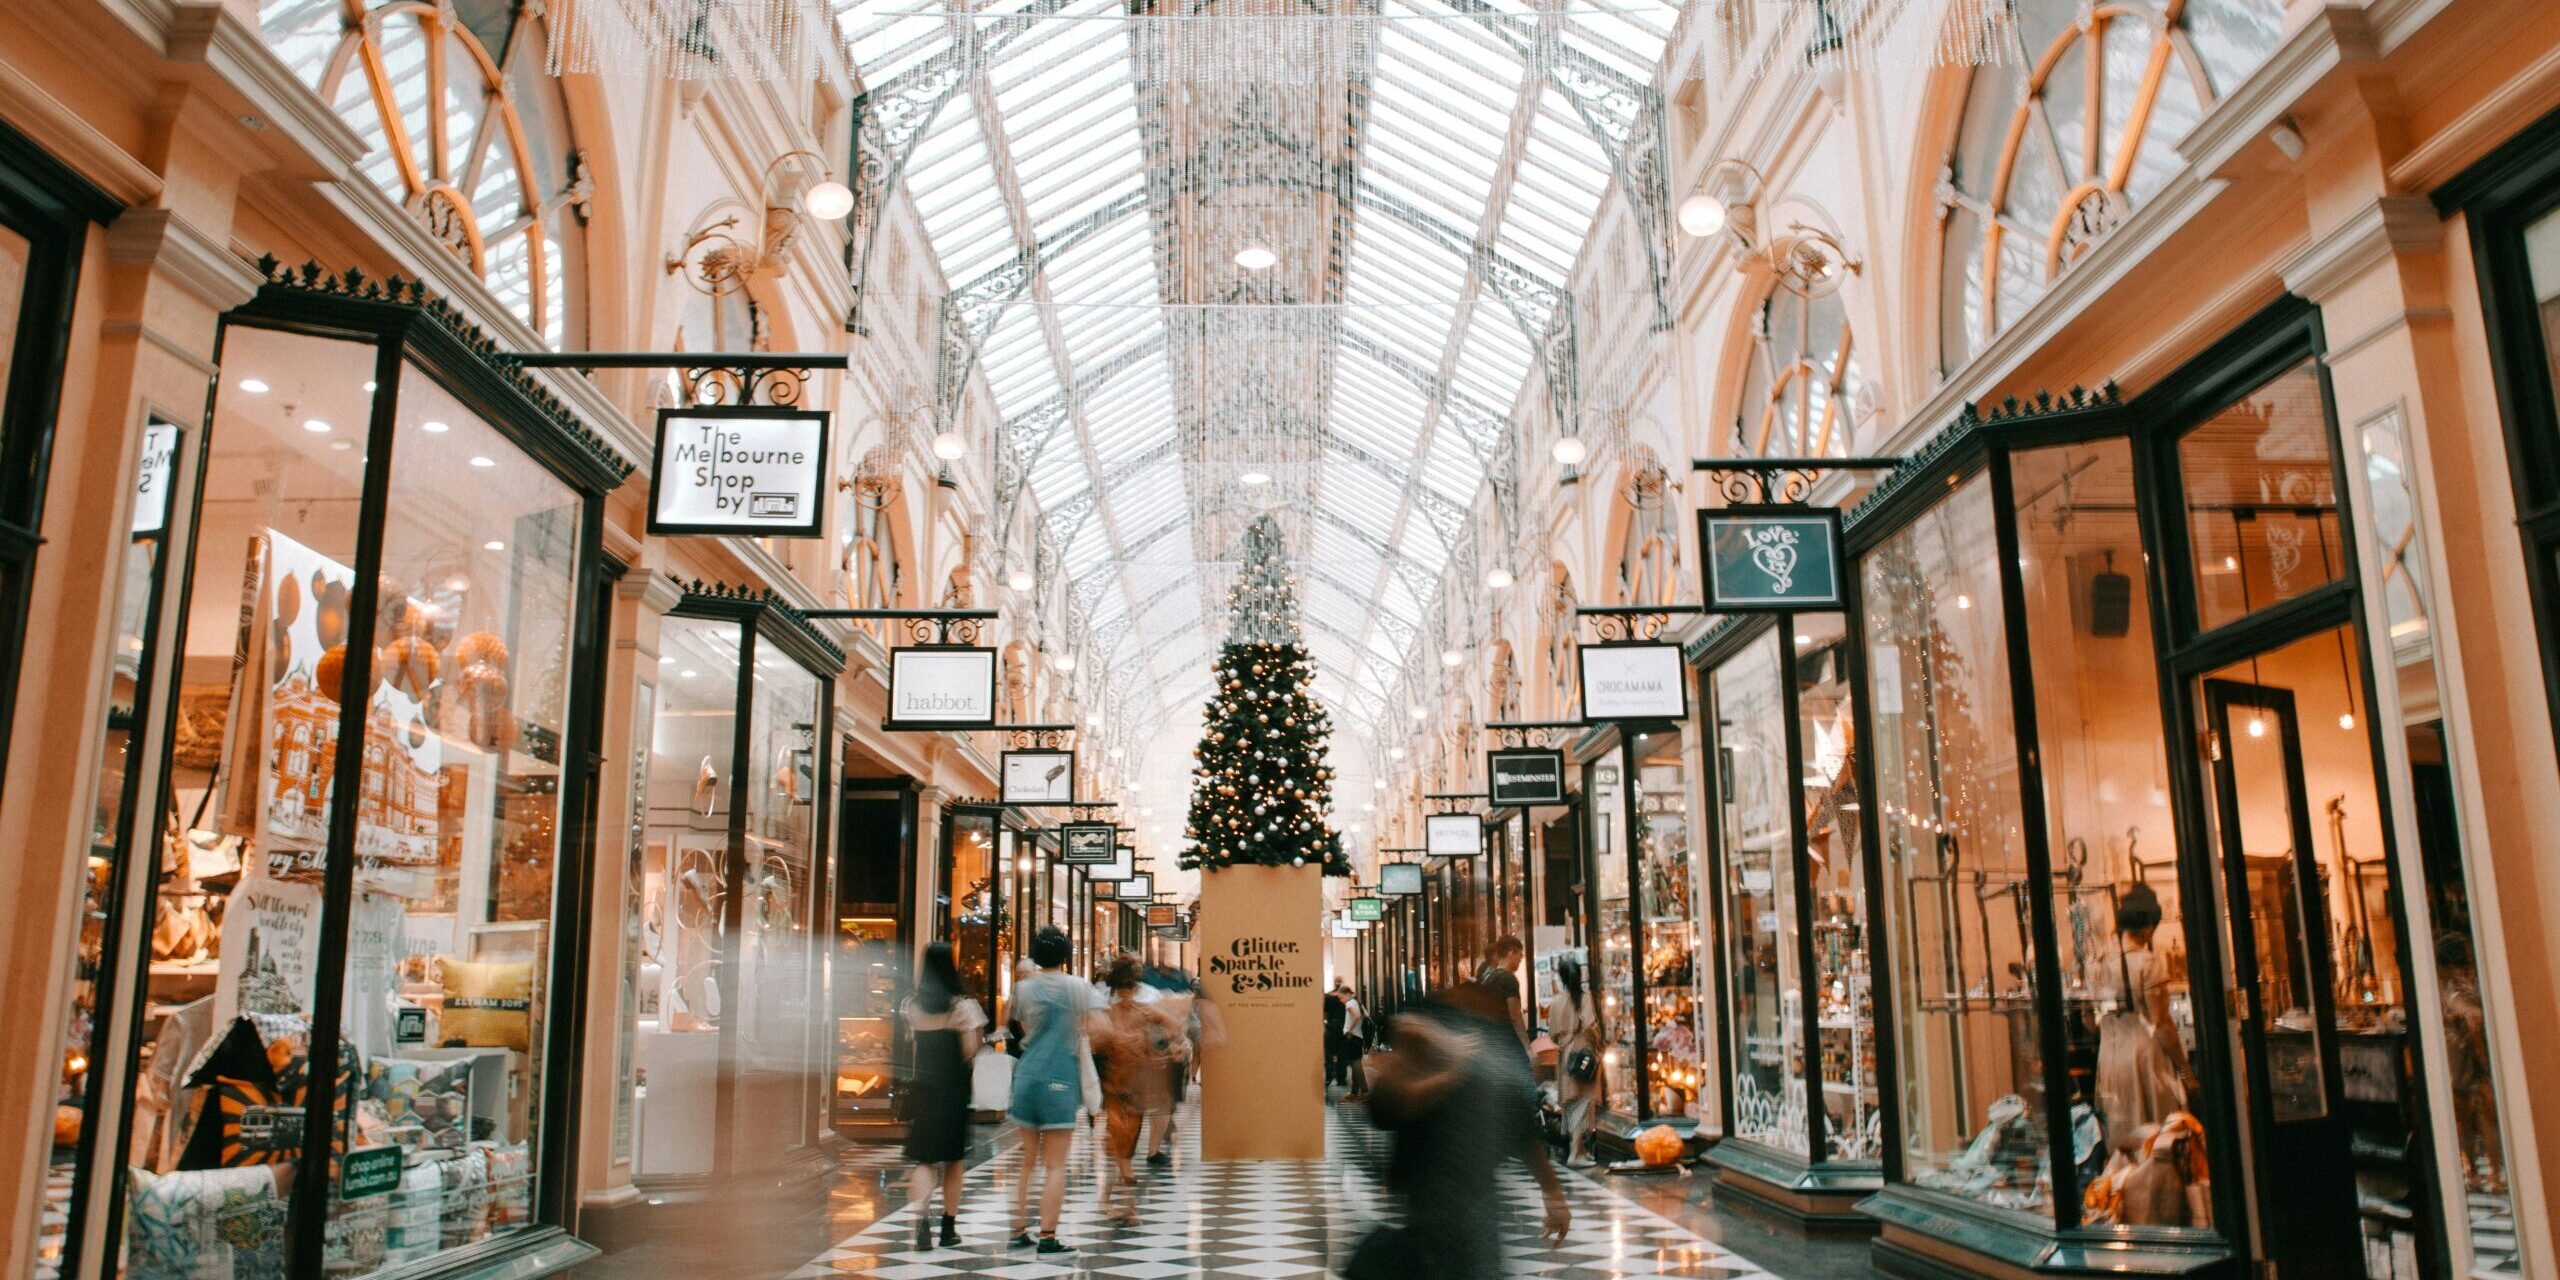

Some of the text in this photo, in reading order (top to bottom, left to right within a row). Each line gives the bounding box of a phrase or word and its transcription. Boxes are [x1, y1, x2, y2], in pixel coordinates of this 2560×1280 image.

[701, 426, 742, 445] The
[675, 443, 805, 465] Melbourne
[694, 467, 755, 493] Shop
[716, 487, 744, 514] by
[1597, 679, 1664, 694] CHOCAMAMA
[906, 692, 978, 711] habbot.
[1209, 954, 1285, 975] Sparkle
